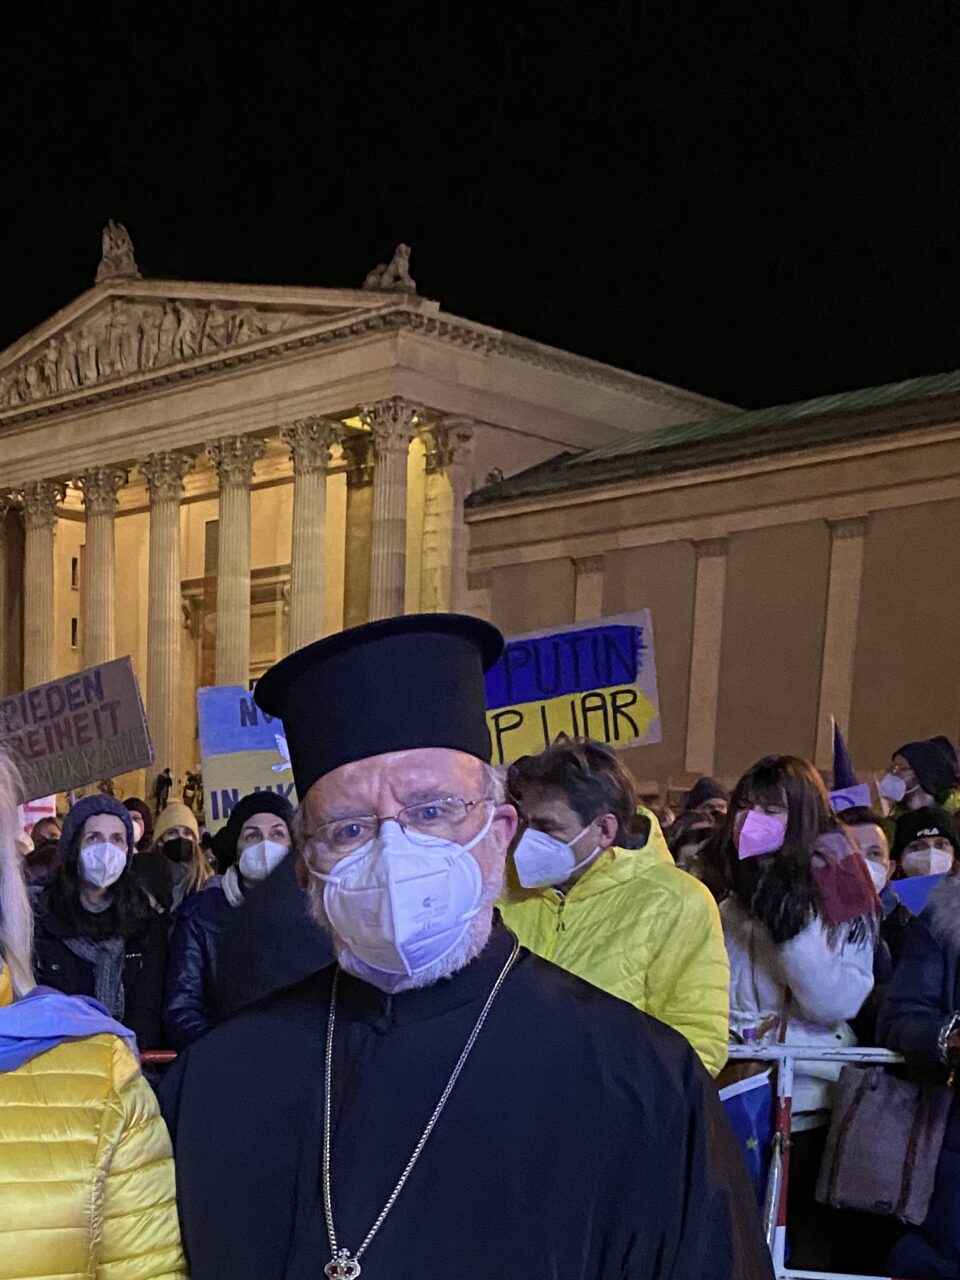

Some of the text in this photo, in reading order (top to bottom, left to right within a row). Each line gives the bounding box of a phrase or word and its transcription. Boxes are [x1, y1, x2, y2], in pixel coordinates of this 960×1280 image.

[503, 627, 638, 702] PUTIN
[490, 689, 640, 766] P WAR
[211, 788, 239, 820] IN
